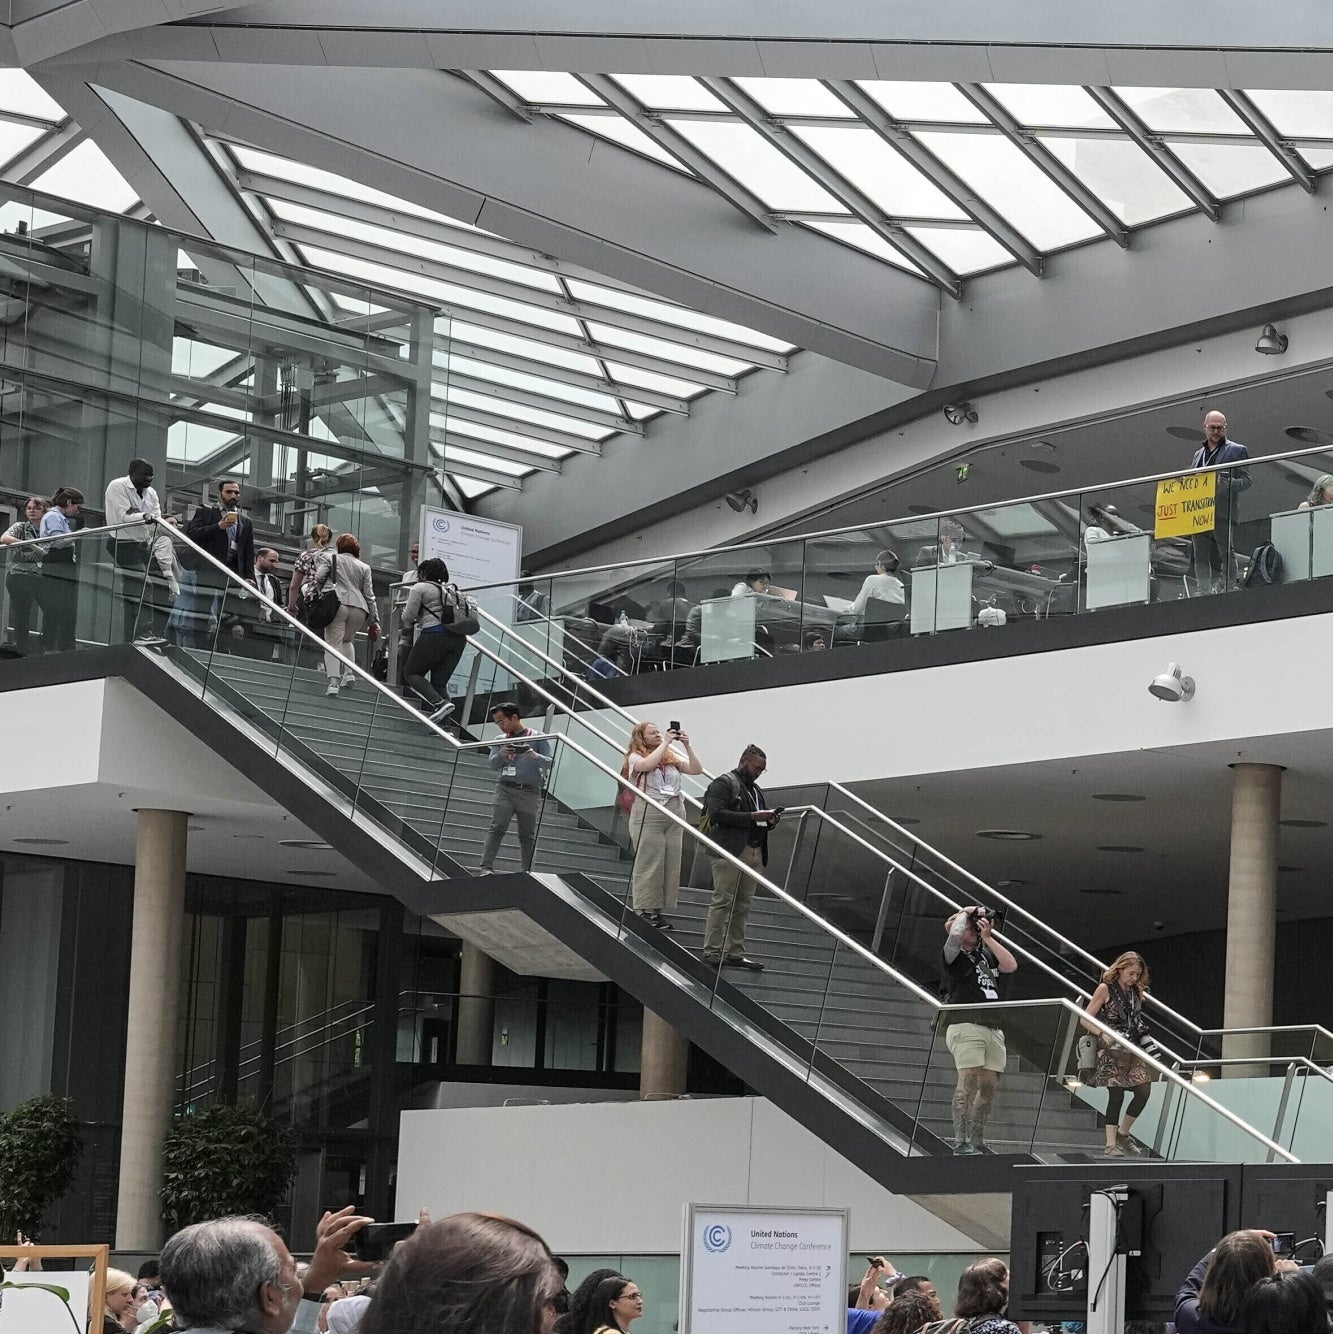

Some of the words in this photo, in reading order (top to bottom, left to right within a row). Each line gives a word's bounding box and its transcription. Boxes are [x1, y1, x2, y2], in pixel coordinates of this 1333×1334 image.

[1163, 481, 1176, 494] WE
[1180, 477, 1199, 491] NEED
[1202, 475, 1208, 487] A
[1157, 503, 1178, 518] JUST
[1192, 512, 1213, 527] NOW!
[750, 1230, 772, 1238] United
[773, 1230, 798, 1238] Nations
[750, 1242, 773, 1250] Climate
[774, 1242, 798, 1251] Change
[799, 1242, 832, 1251] Conference
